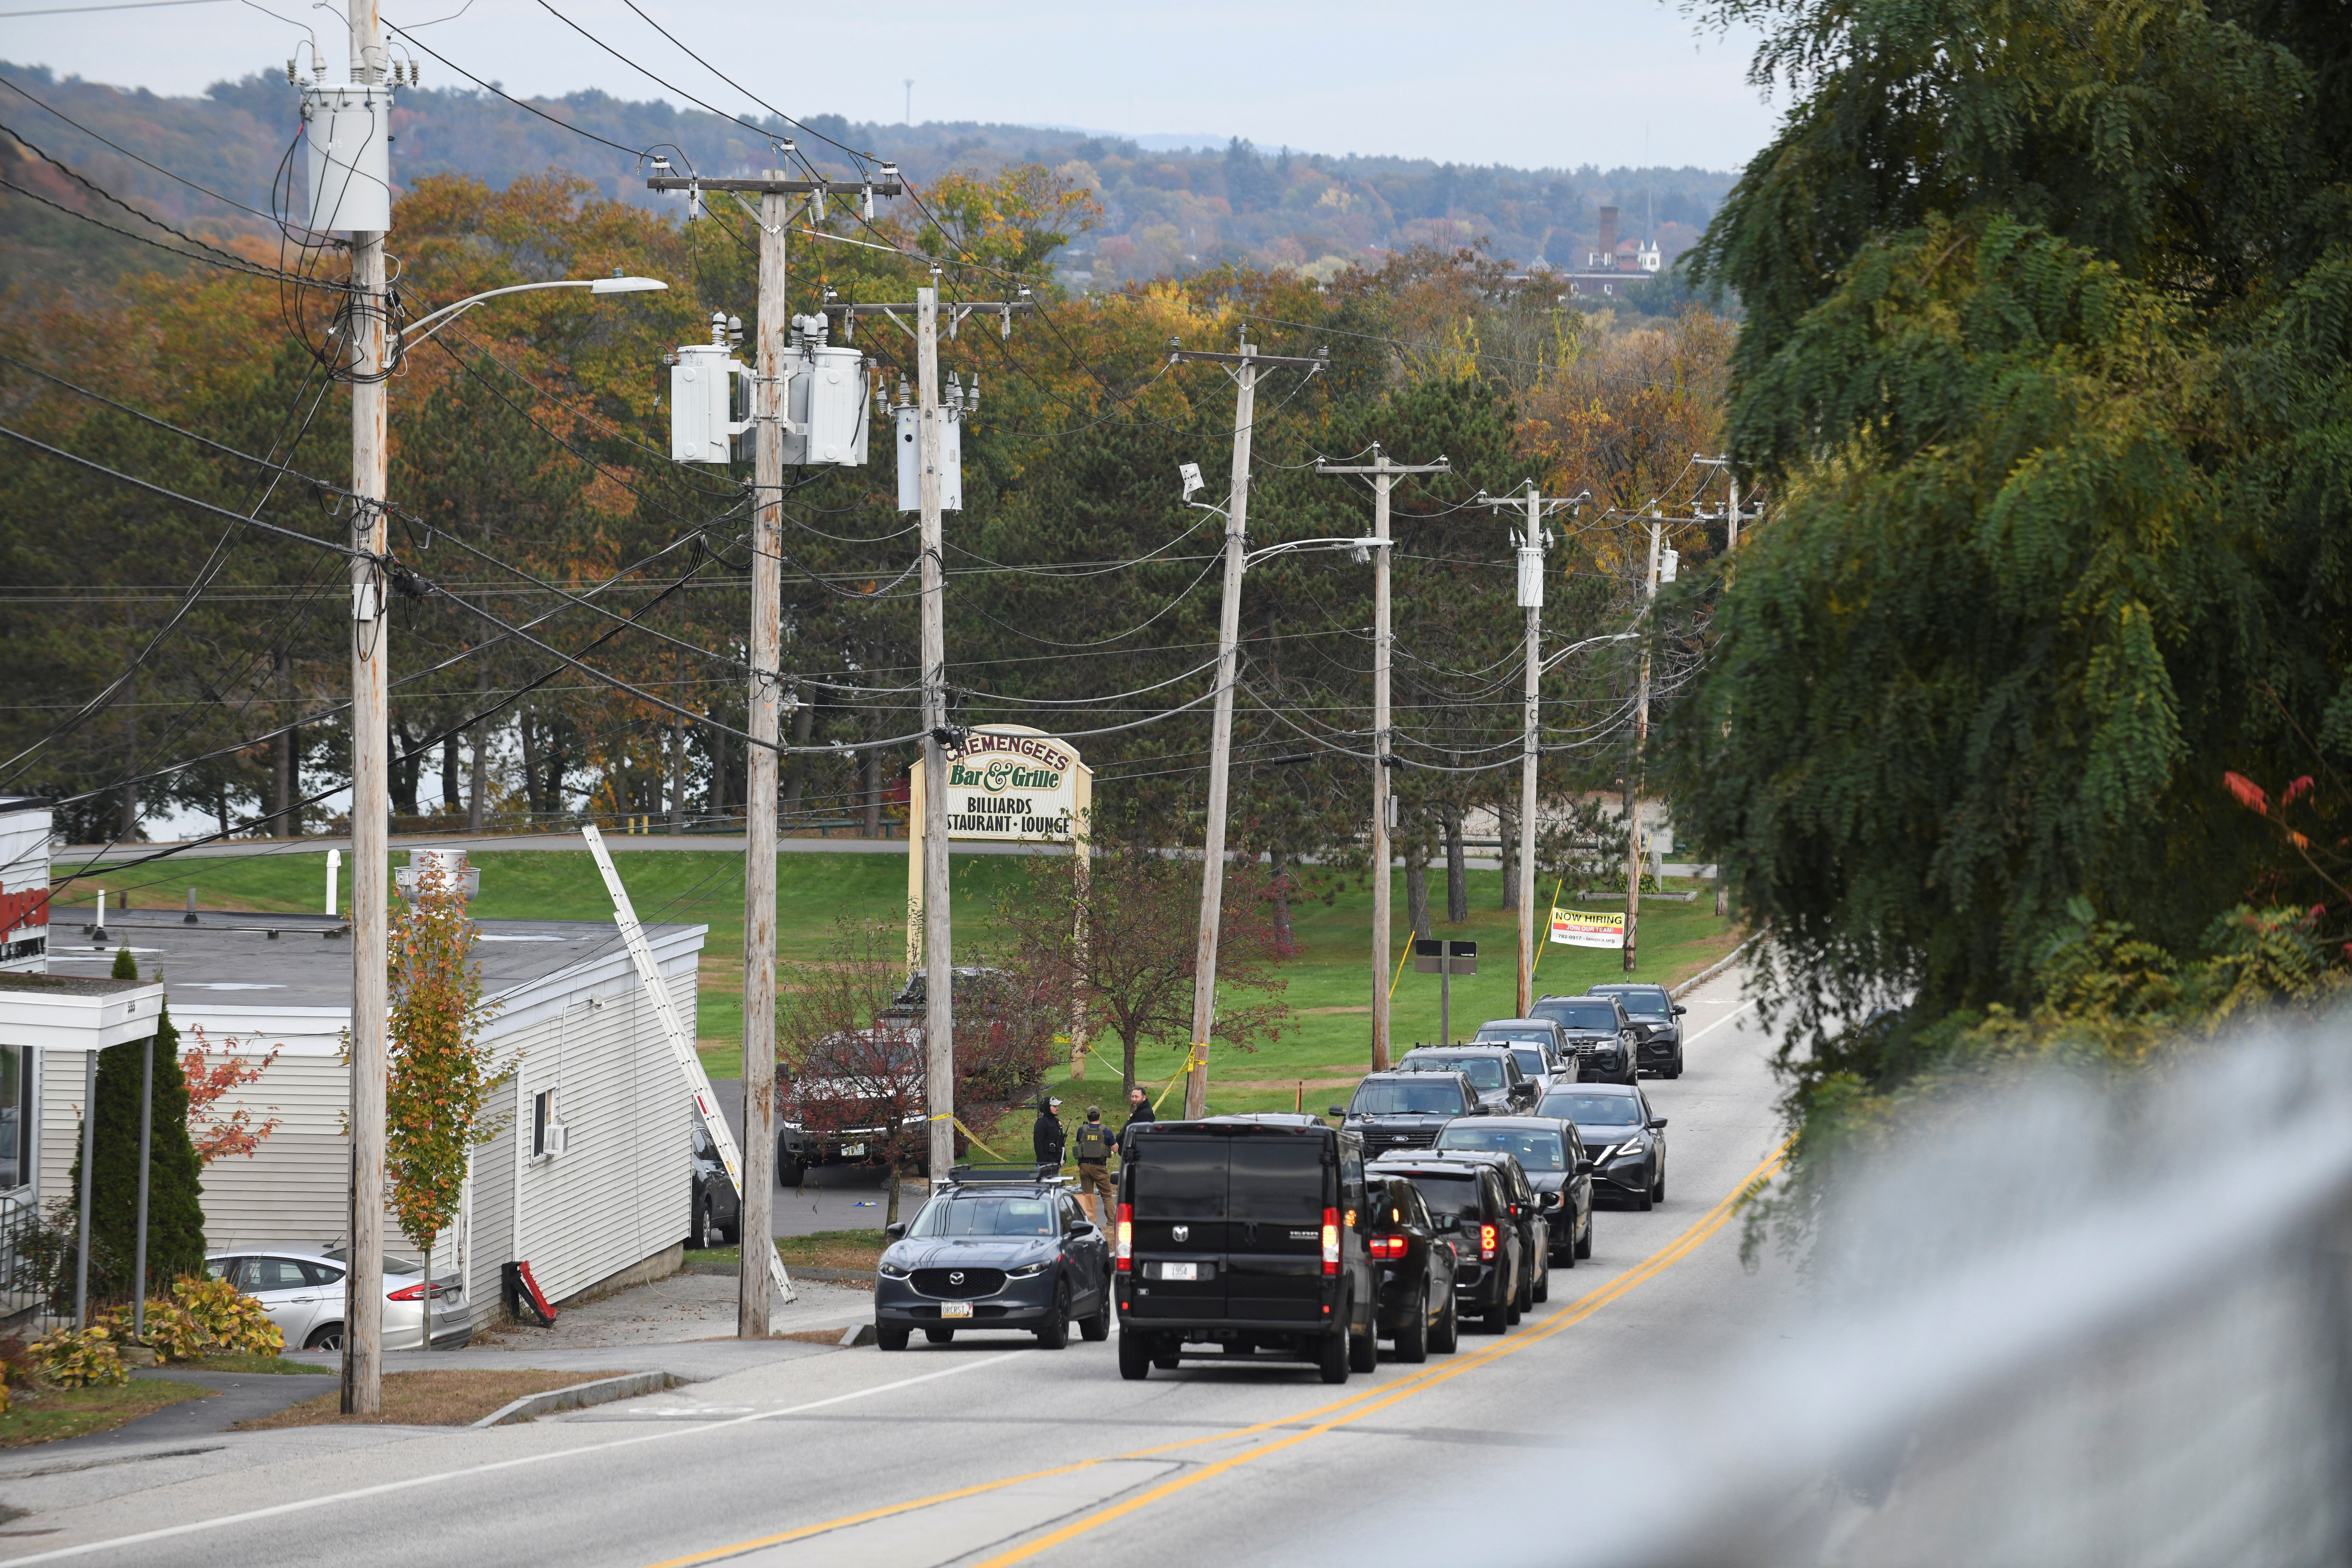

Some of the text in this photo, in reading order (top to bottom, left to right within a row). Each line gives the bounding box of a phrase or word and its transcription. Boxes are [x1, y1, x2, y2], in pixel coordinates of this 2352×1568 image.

[946, 736, 1069, 771] CHEMENGEES
[949, 762, 1059, 792] Bar & Grille
[968, 797, 1032, 814] BILLIARDS
[948, 814, 1069, 833] STAURANT LOUNGE
[1556, 912, 1622, 924] NOW HIRING
[1172, 1267, 1187, 1276] 1954
